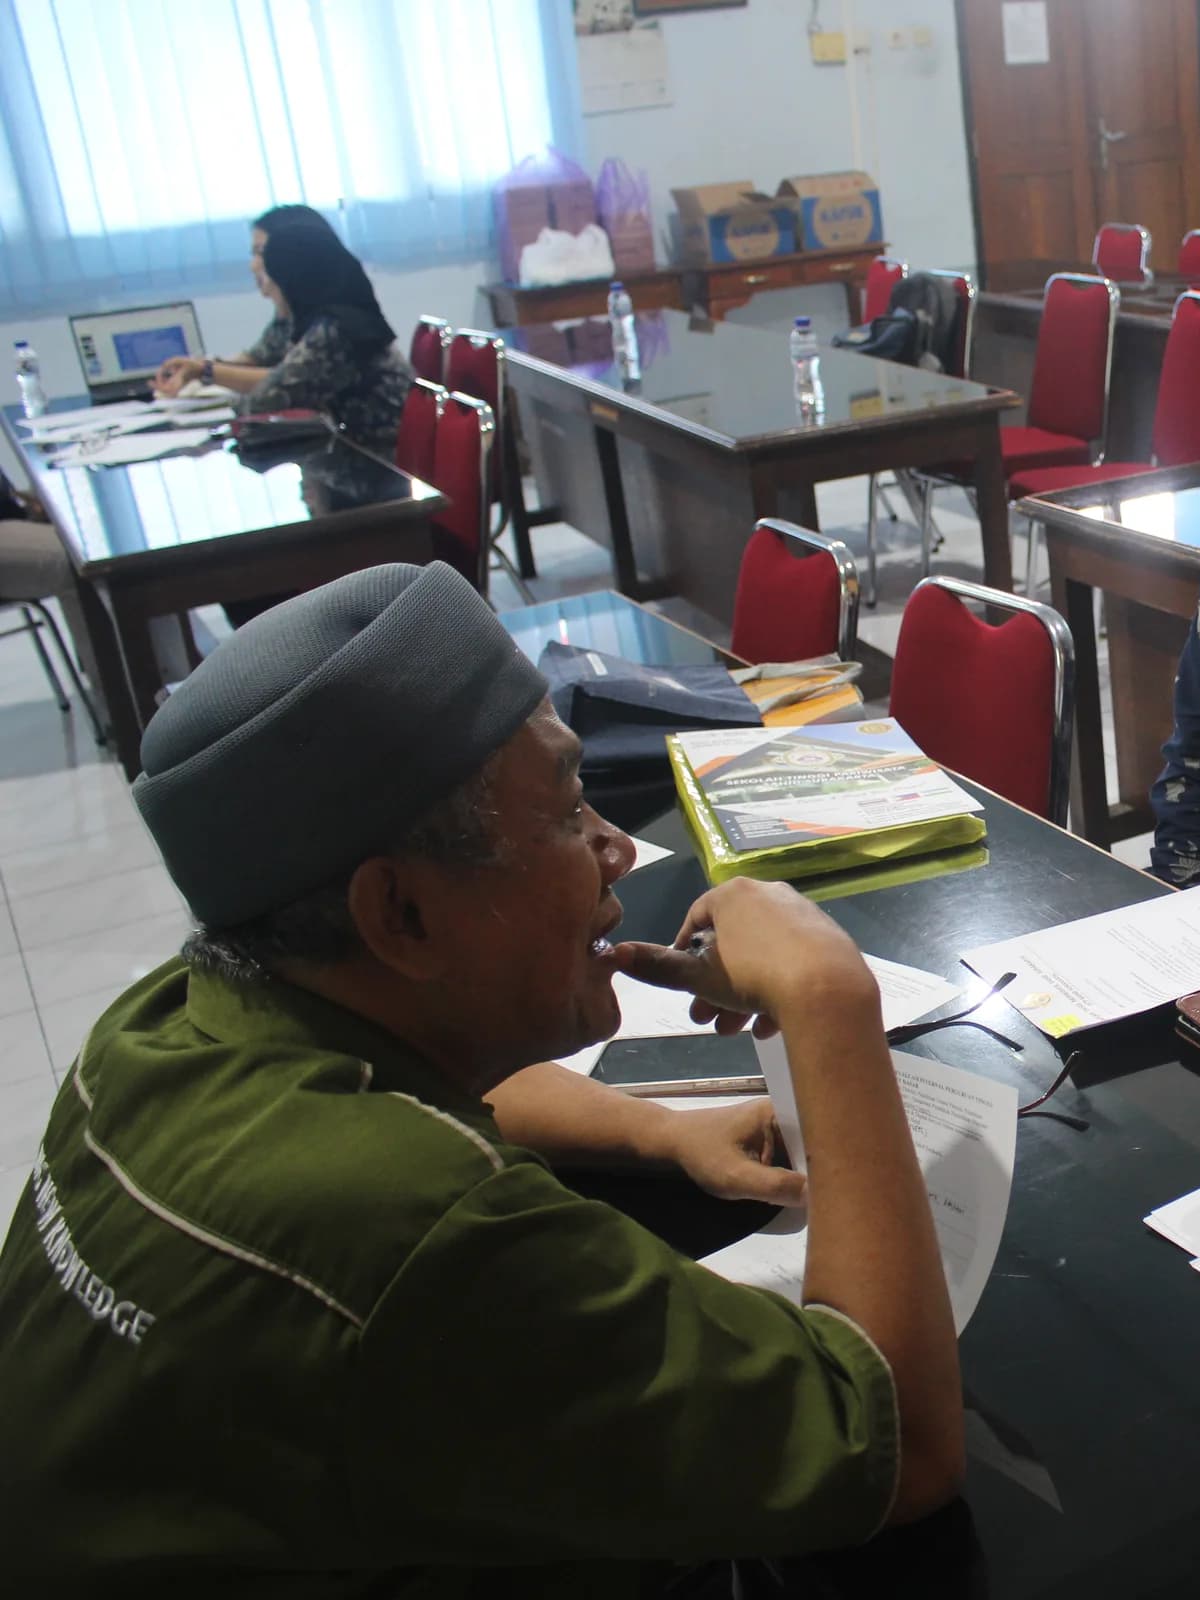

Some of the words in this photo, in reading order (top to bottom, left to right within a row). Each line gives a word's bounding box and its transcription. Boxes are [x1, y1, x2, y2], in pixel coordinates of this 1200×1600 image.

[726, 776, 783, 786] SEKOLAH
[785, 772, 831, 782] TINGGI
[43, 1216, 157, 1345] KNOWLEDGE
